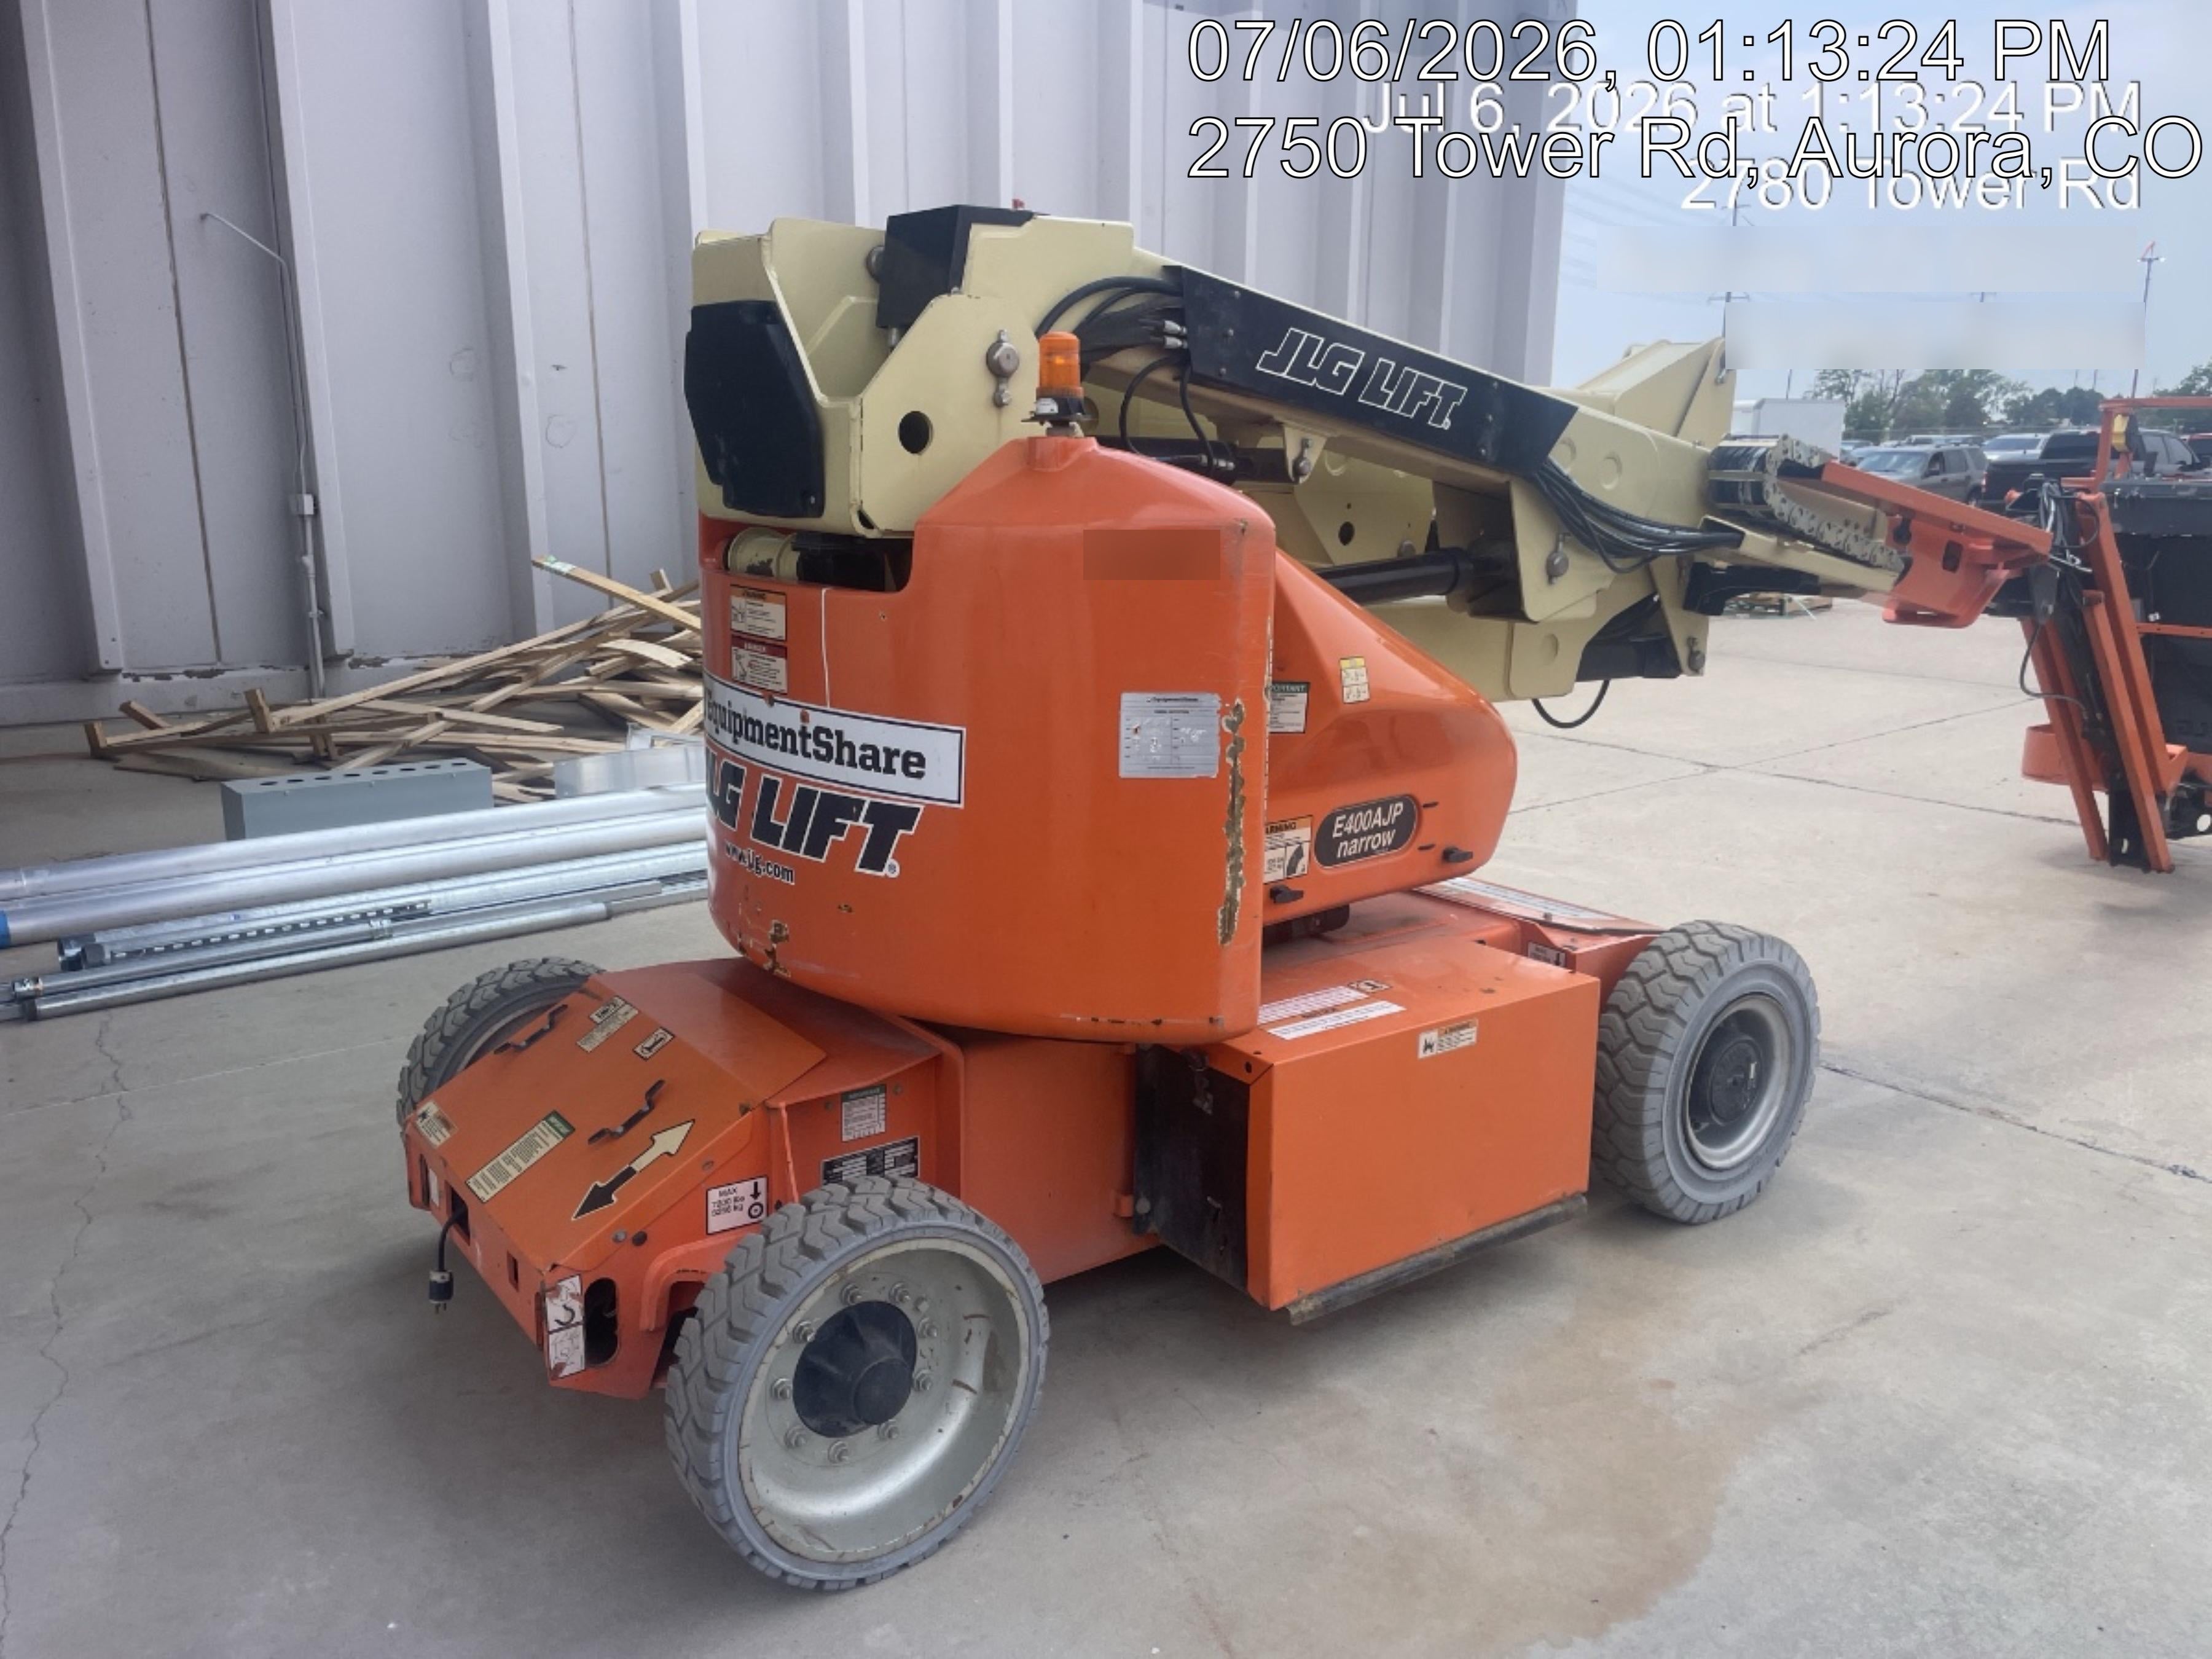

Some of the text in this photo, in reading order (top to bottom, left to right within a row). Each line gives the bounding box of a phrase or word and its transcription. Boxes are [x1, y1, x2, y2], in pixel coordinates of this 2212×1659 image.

[1255, 327, 1468, 430] JLG LIFT
[750, 773, 925, 877] LIFT
[1332, 801, 1405, 839] E400AJP
[1336, 829, 1397, 859] narrow
